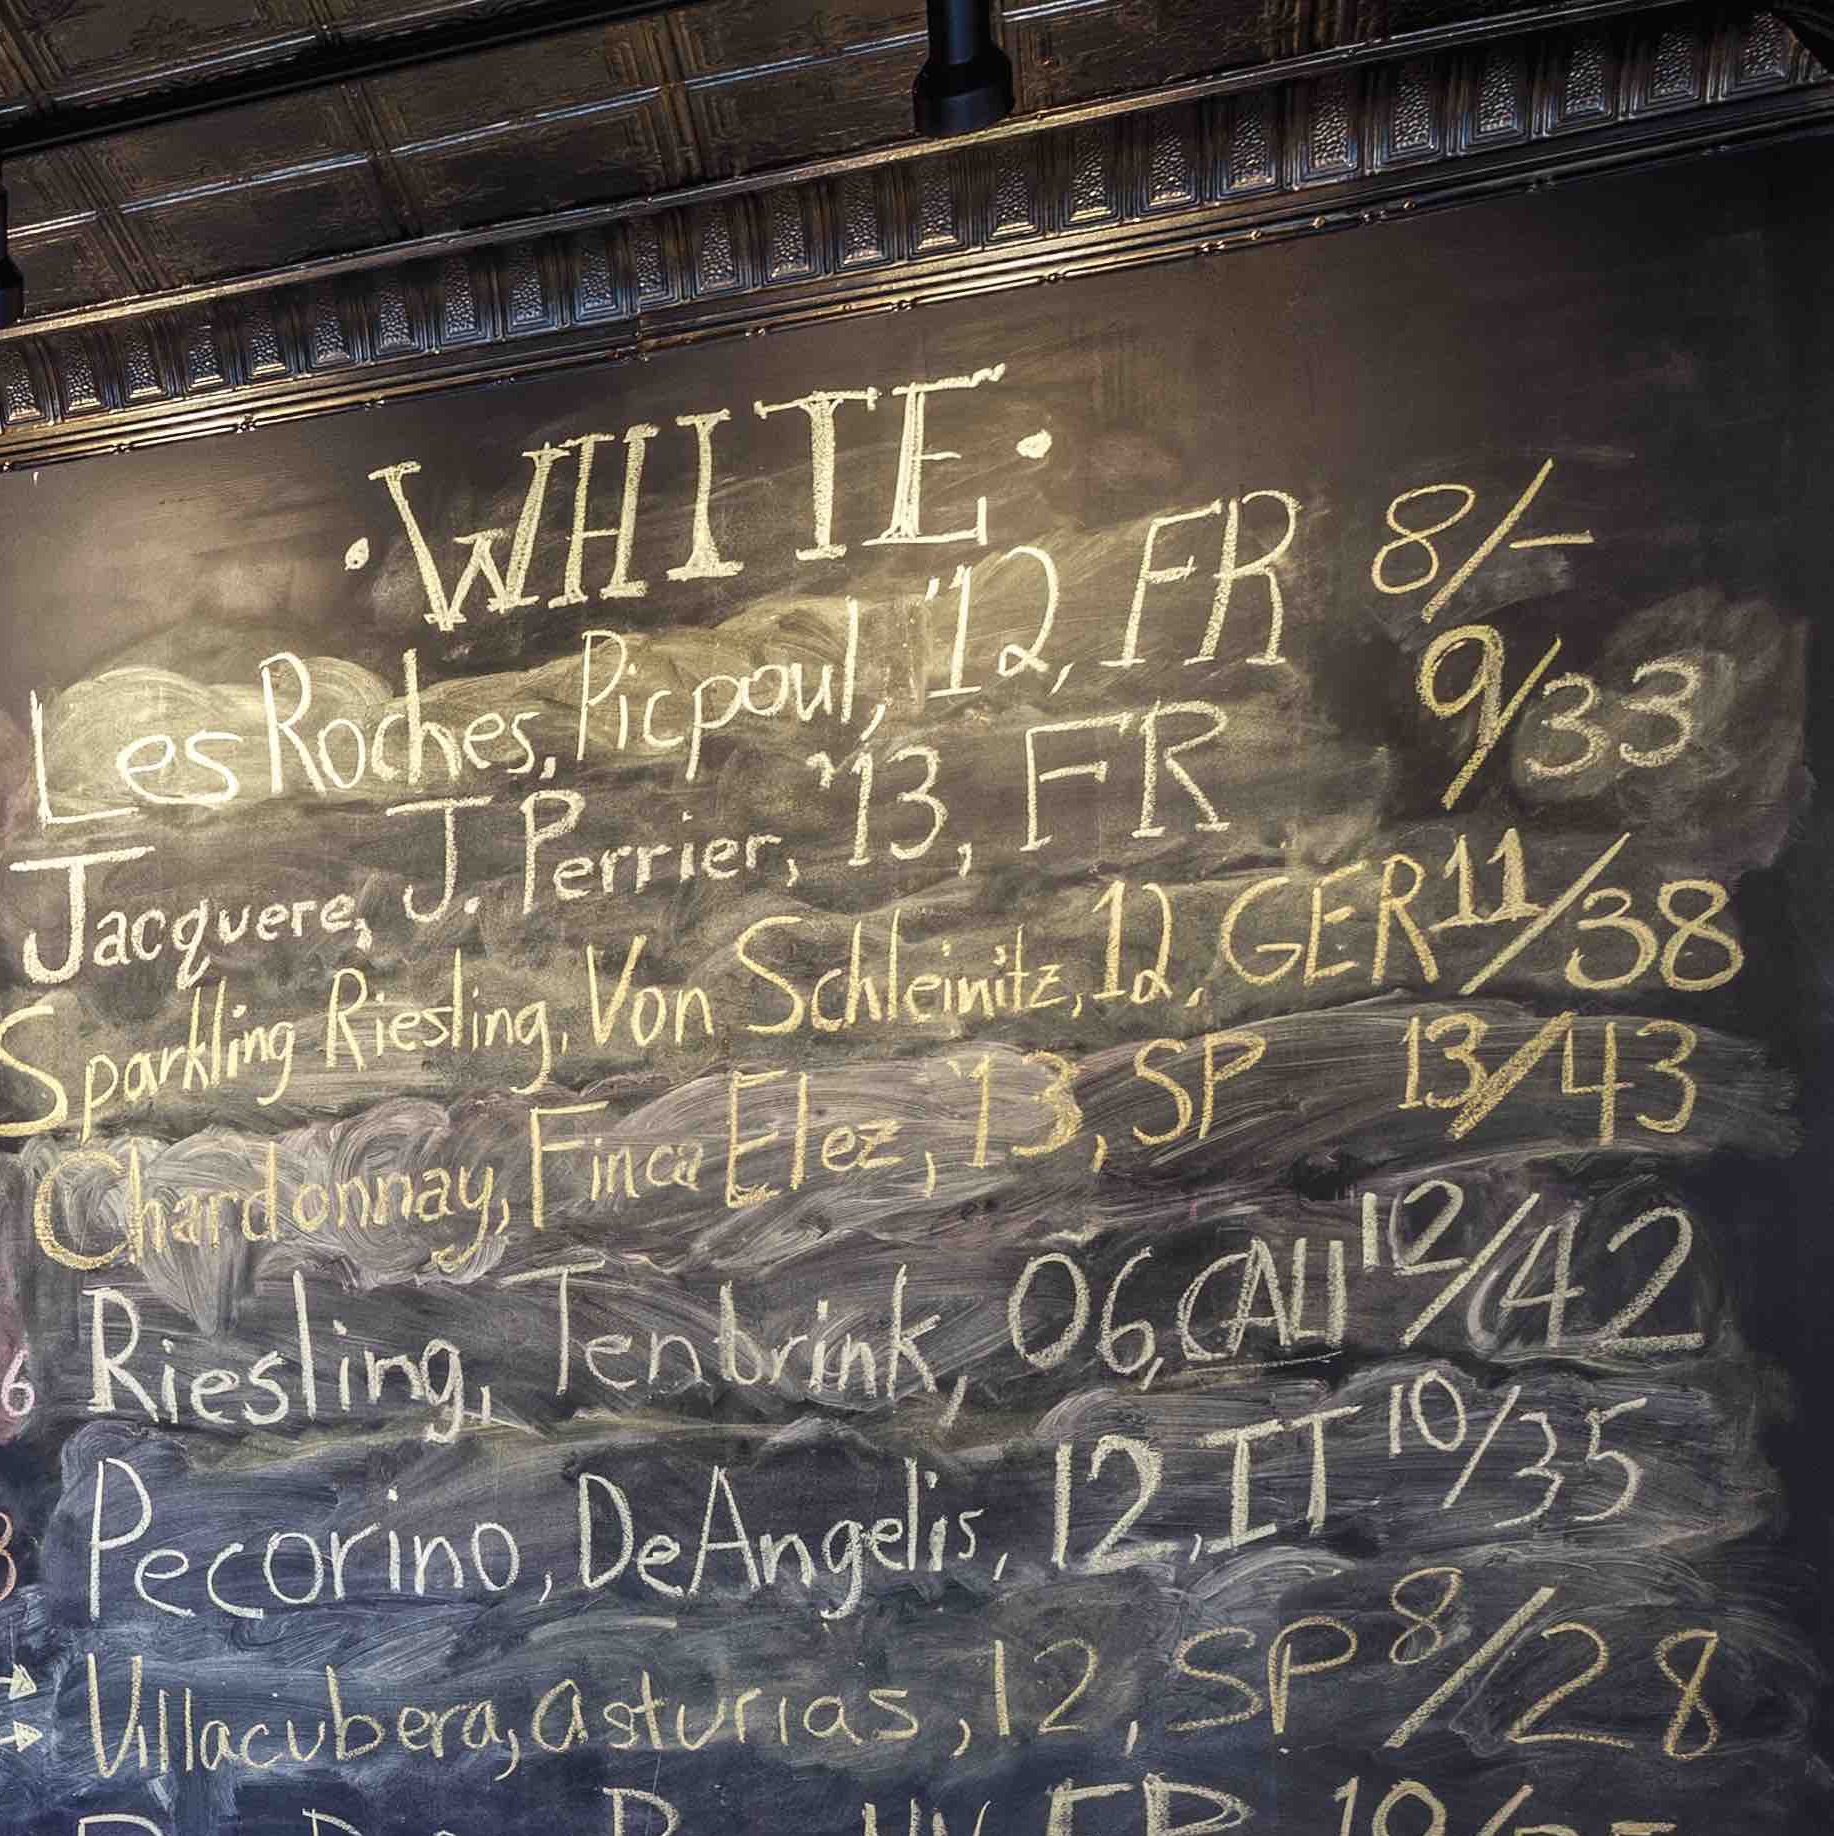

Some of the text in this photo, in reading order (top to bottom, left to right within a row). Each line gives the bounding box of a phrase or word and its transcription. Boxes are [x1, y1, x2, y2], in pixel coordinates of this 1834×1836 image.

[368, 364, 1006, 631] WHITE
[29, 689, 243, 830] Les
[259, 648, 556, 796] Roches,
[1100, 490, 1300, 667] FR
[9, 845, 372, 990] Jacquere,
[386, 796, 492, 923] J.
[521, 790, 799, 914] Perrier,
[1019, 700, 1230, 852] FR
[1417, 624, 1703, 811] 9/33
[326, 948, 568, 1096] Riesling,
[585, 935, 714, 1047] Von
[1221, 853, 1439, 988] GER
[1429, 828, 1744, 995] 11/38
[34, 1140, 510, 1273] Chardonnay,
[528, 1101, 704, 1230] Finca
[1132, 1030, 1267, 1146] SP
[1398, 1011, 1697, 1145] 13/43
[83, 1270, 491, 1443] Riesling,
[1361, 1179, 1703, 1349] 12/42
[88, 1457, 553, 1620] Pecorino,
[1196, 1405, 1362, 1553] IT
[1388, 1369, 1648, 1530] 10/35
[1168, 1614, 1358, 1736] SP
[1383, 1566, 1721, 1760] 8/28
